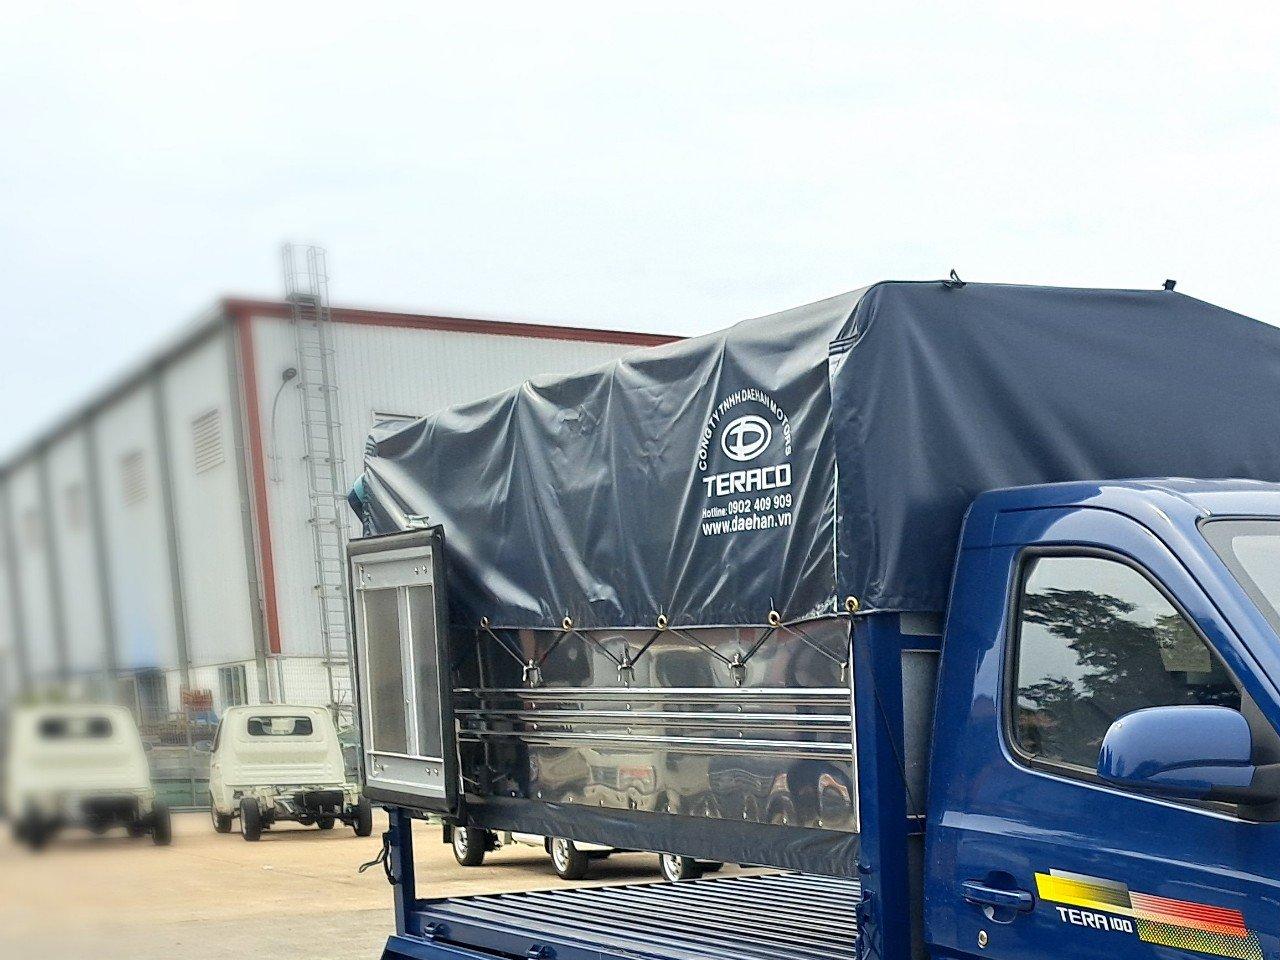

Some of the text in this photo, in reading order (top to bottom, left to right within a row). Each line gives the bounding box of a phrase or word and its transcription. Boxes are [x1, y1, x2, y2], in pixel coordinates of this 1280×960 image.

[708, 409, 721, 429] TY
[718, 390, 742, 415] TNHH
[741, 388, 770, 408] DAEHAN
[770, 399, 792, 456] MOTORS
[702, 462, 792, 498] TERACO
[728, 501, 752, 515] 0902
[753, 496, 771, 512] 409
[773, 493, 792, 509] 909
[702, 512, 792, 536] www.daehan.vn
[1055, 906, 1133, 934] TERA 100
